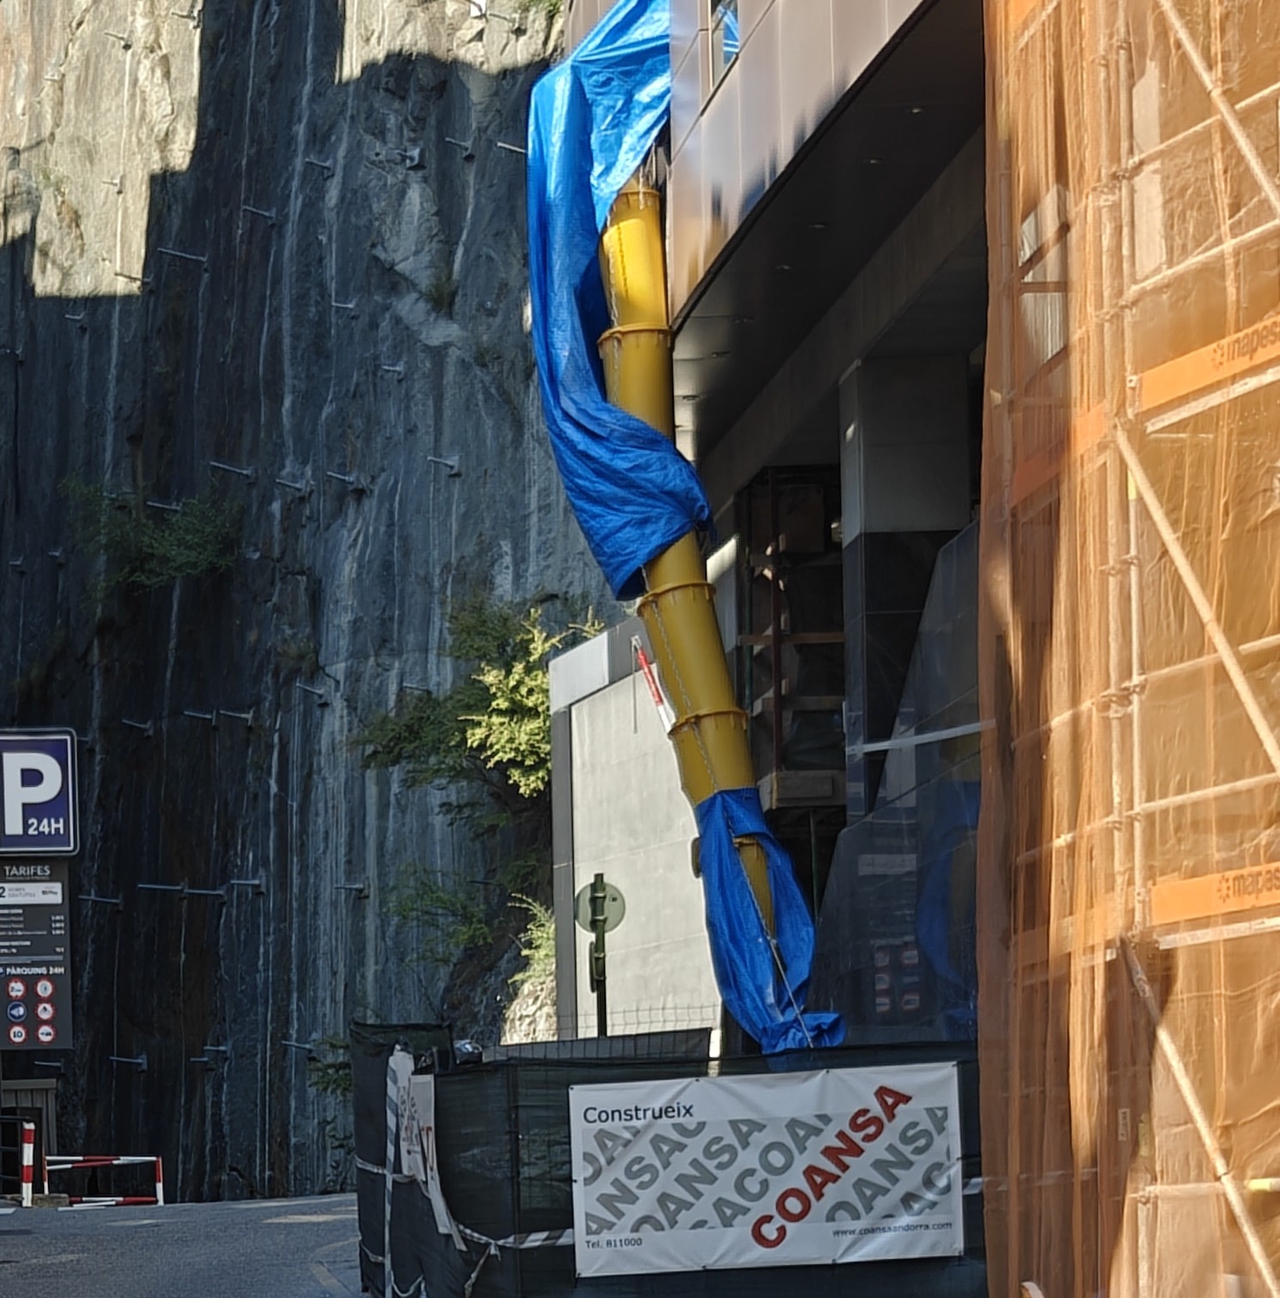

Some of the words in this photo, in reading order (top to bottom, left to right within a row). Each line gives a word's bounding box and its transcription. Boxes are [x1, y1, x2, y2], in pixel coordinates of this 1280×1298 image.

[2, 751, 62, 836] P
[27, 817, 64, 836] 24H
[3, 865, 51, 877] TARIFES
[583, 1102, 694, 1124] Construeix
[751, 1085, 913, 1249] COANSA
[585, 1239, 602, 1249] Tel.
